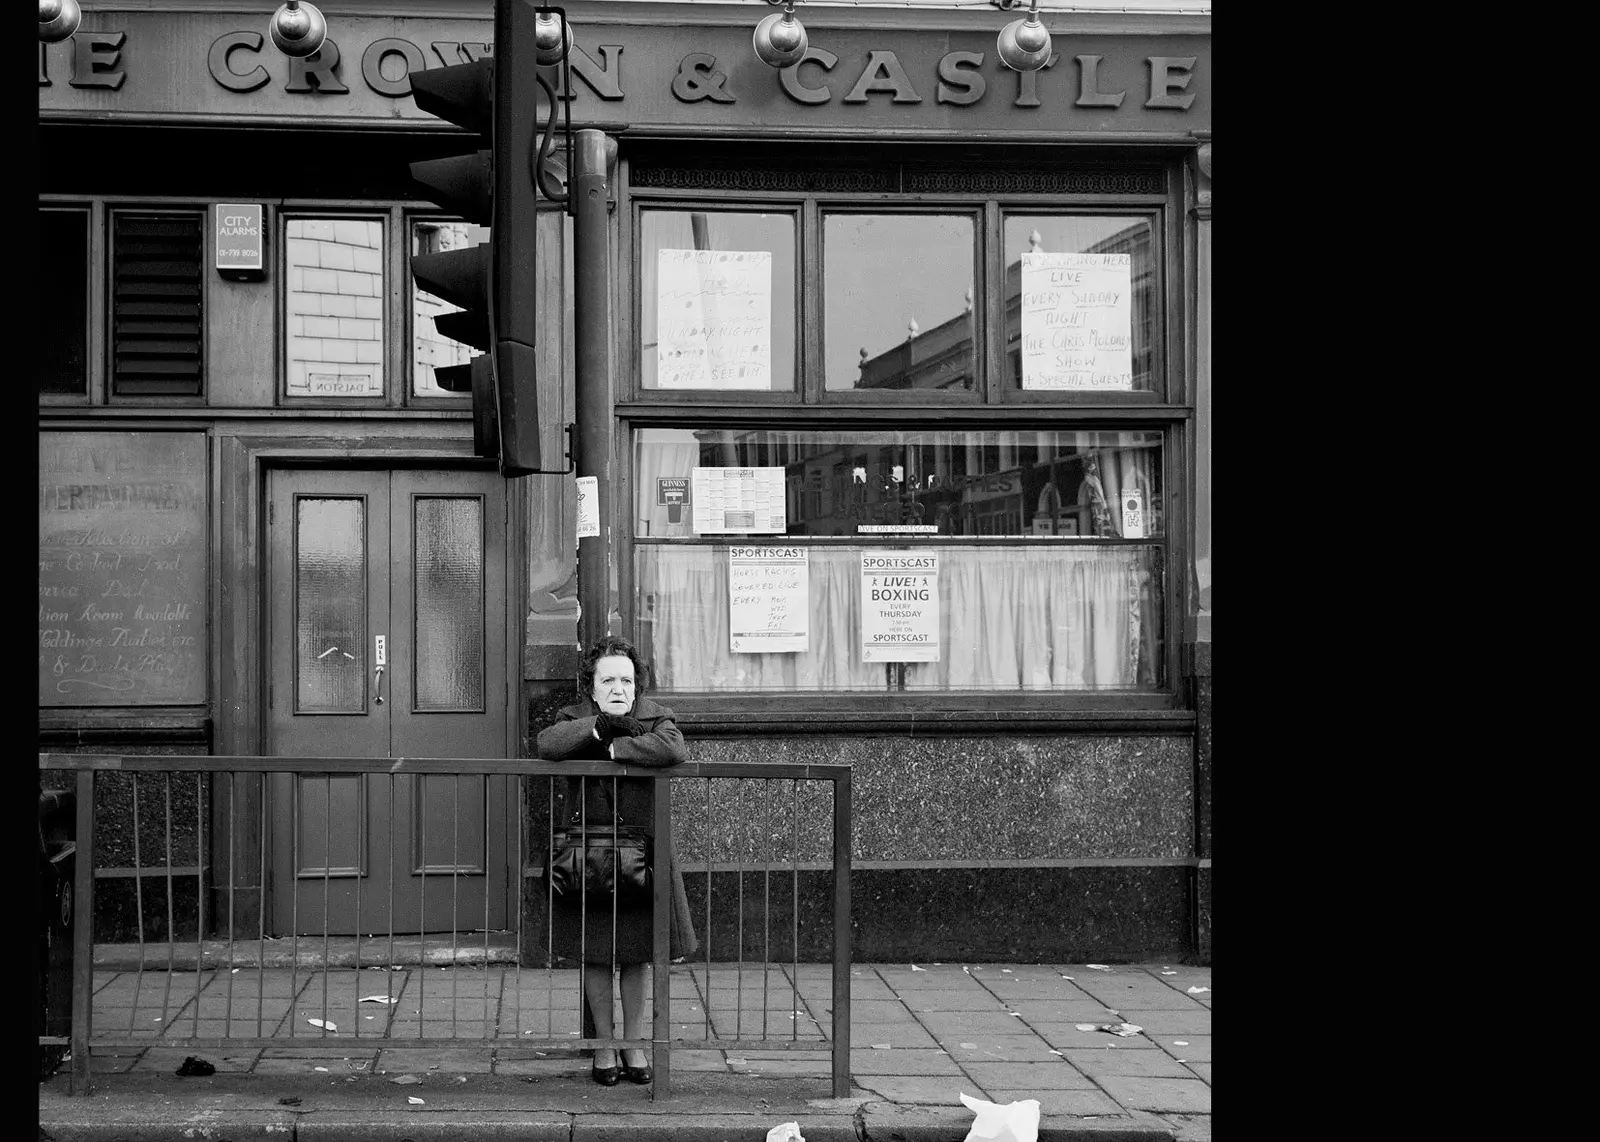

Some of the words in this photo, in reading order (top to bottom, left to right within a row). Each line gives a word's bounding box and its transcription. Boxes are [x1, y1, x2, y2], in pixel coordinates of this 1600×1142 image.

[208, 31, 625, 101] CRON
[671, 52, 737, 103] &
[778, 46, 1197, 109] CASTLE
[224, 216, 251, 226] CITY
[220, 227, 257, 236] ALARMS
[1103, 255, 1131, 266] HERE
[1051, 272, 1083, 282] LIVE
[1023, 291, 1061, 305] EVERY
[1046, 311, 1089, 325] NIGHT
[1023, 333, 1044, 350] THE
[1052, 331, 1085, 349] CHRIS
[1056, 355, 1095, 367] SHOW
[711, 369, 735, 380] SEE
[1040, 372, 1085, 386] SPECIAL
[1091, 372, 1133, 386] GUESTS
[731, 548, 806, 558] SPORTSCAST
[863, 558, 936, 567] SPORTSCAST
[883, 577, 917, 587] LIVE!
[871, 589, 929, 601] BOXING
[733, 596, 762, 606] EVERY
[880, 610, 922, 618] THURSDAY
[873, 634, 929, 642] SPORTSCAST
